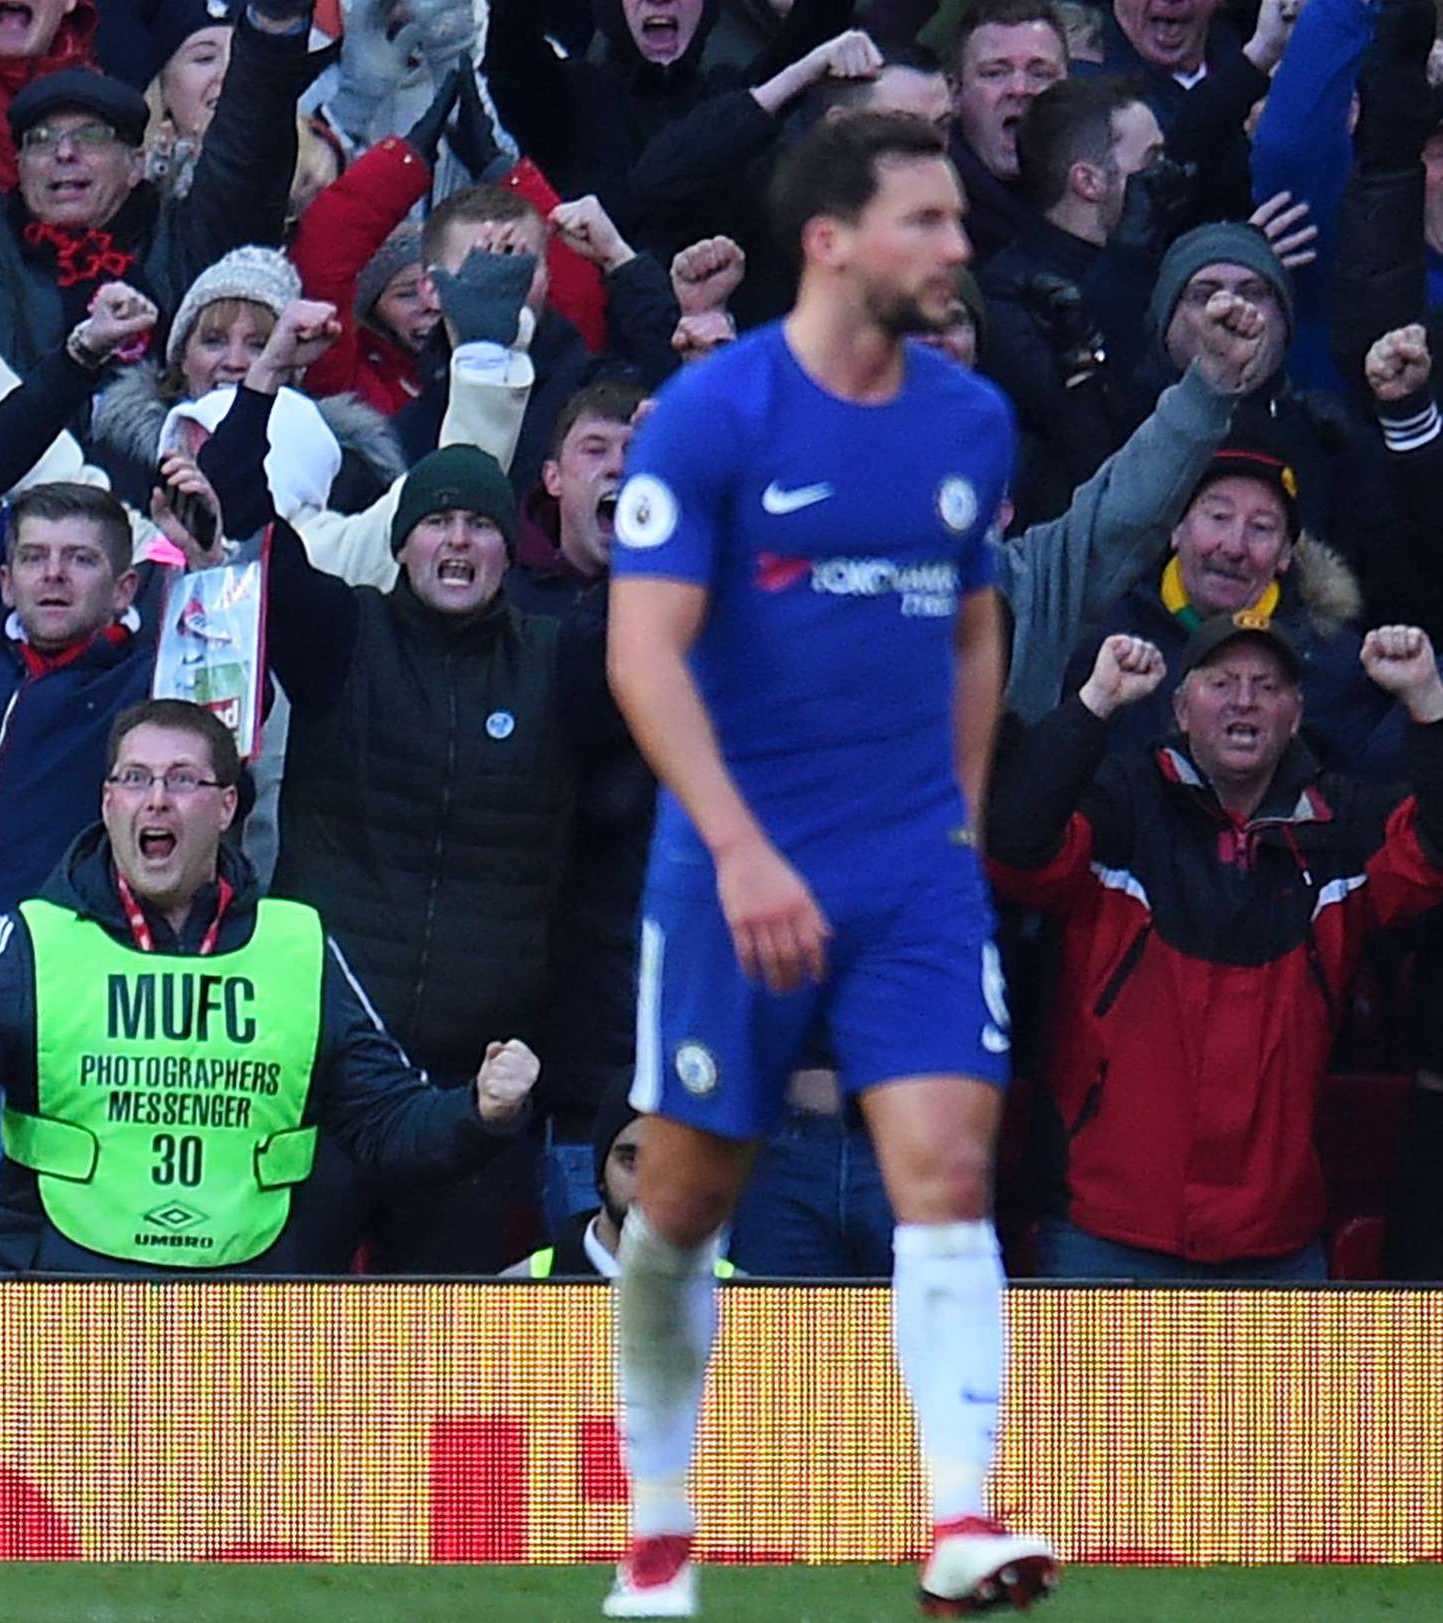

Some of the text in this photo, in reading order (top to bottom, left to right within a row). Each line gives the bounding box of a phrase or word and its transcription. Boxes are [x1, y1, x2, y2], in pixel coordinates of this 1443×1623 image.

[106, 972, 257, 1045] MUFC
[79, 1054, 282, 1097] PHOTOGRAPHERS
[107, 1090, 252, 1130] MESSENGER
[150, 1133, 204, 1188] 30
[133, 1233, 215, 1249] UMBRO
